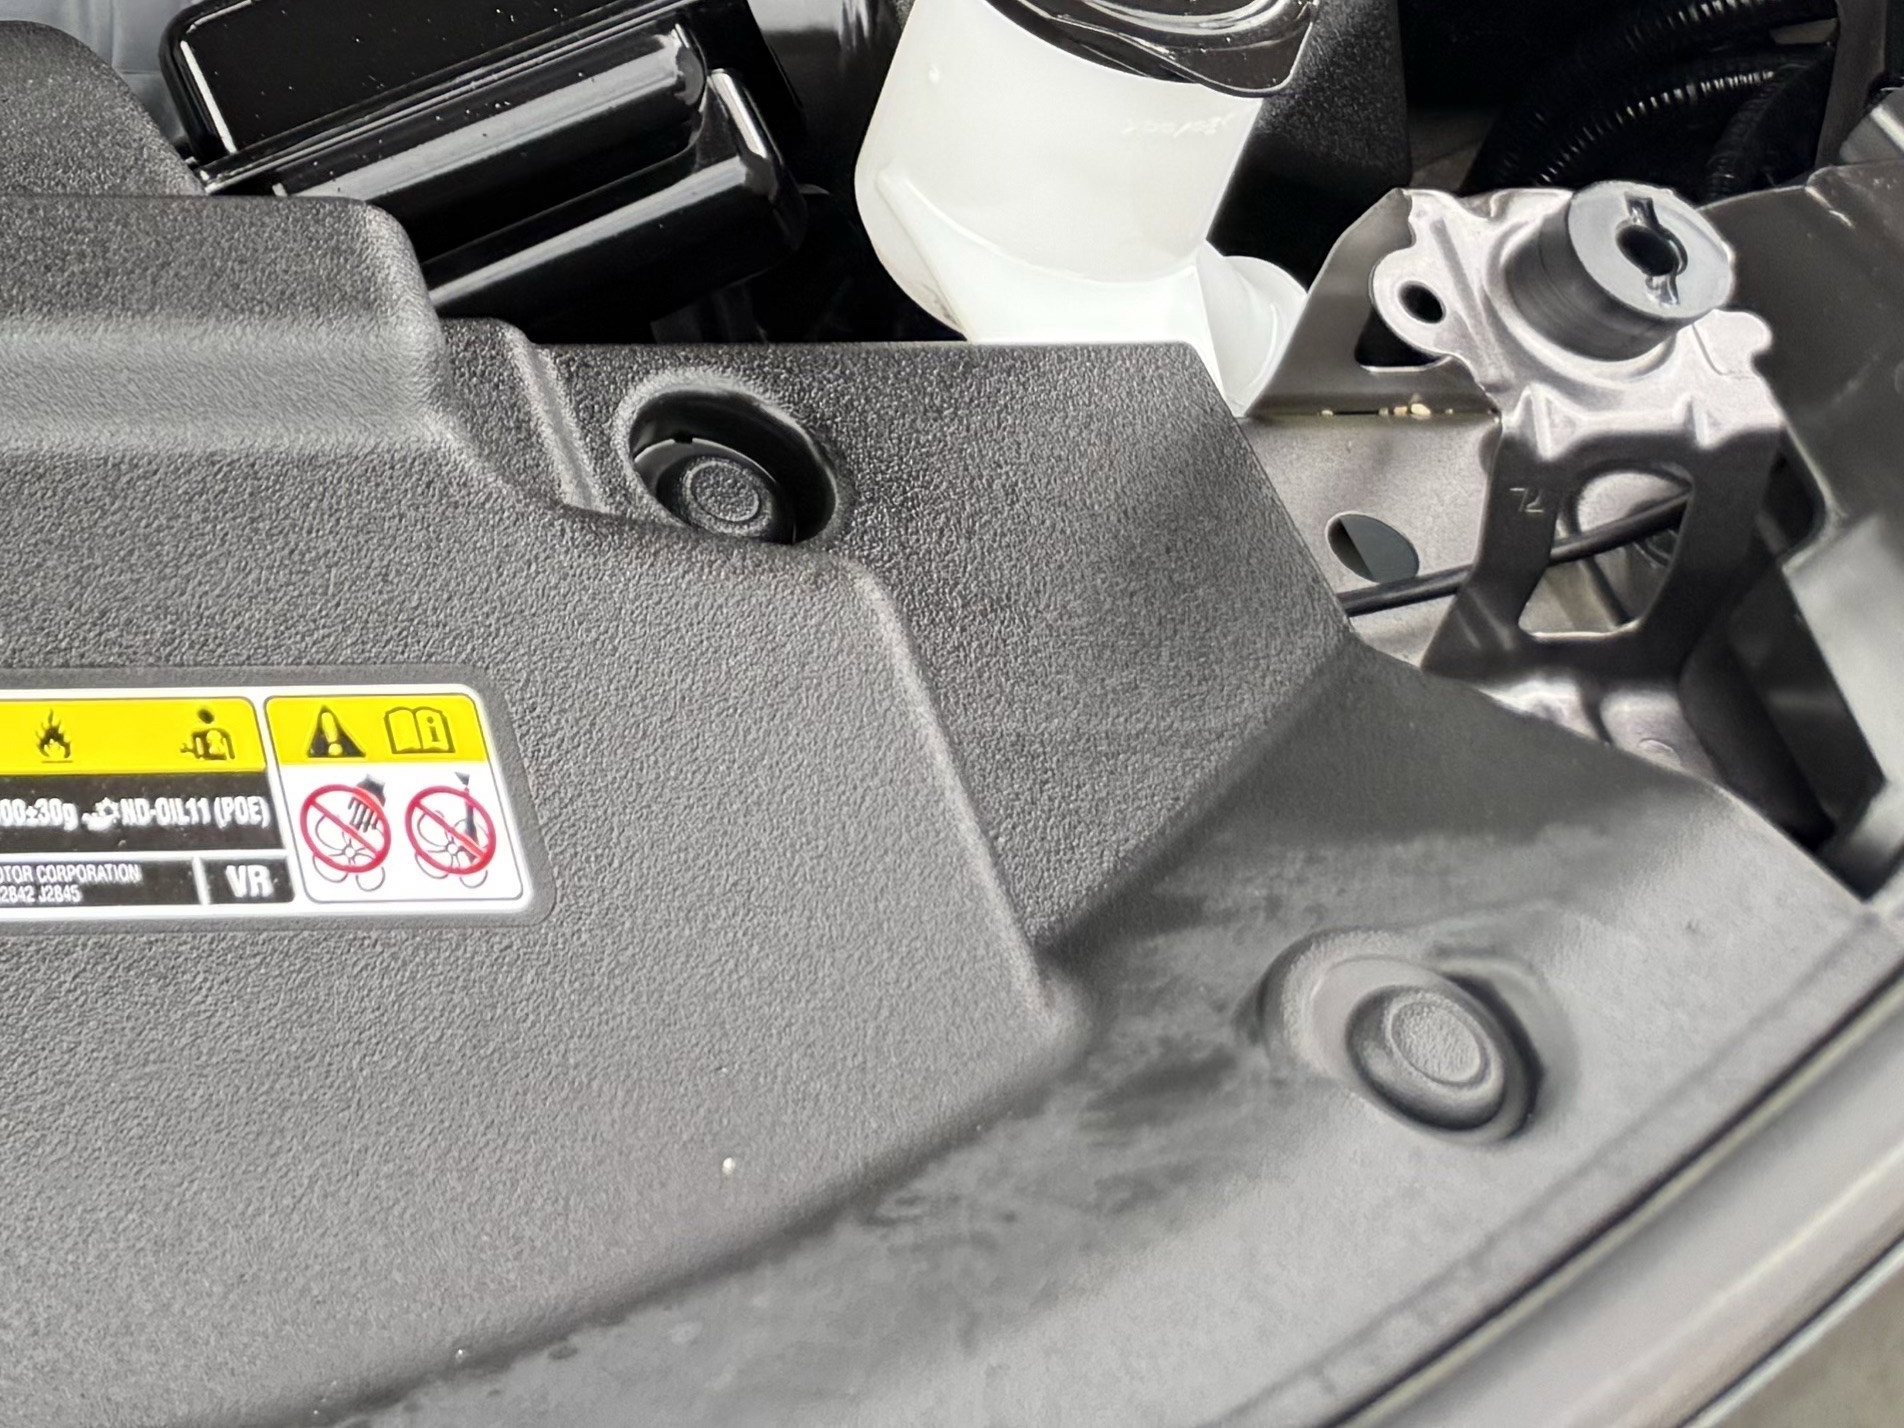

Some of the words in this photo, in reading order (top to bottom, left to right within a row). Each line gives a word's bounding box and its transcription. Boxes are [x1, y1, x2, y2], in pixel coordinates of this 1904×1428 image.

[214, 796, 271, 829] (POE)
[36, 863, 142, 883] CORPORATION
[225, 864, 274, 898] VR
[38, 885, 83, 904] J2845
